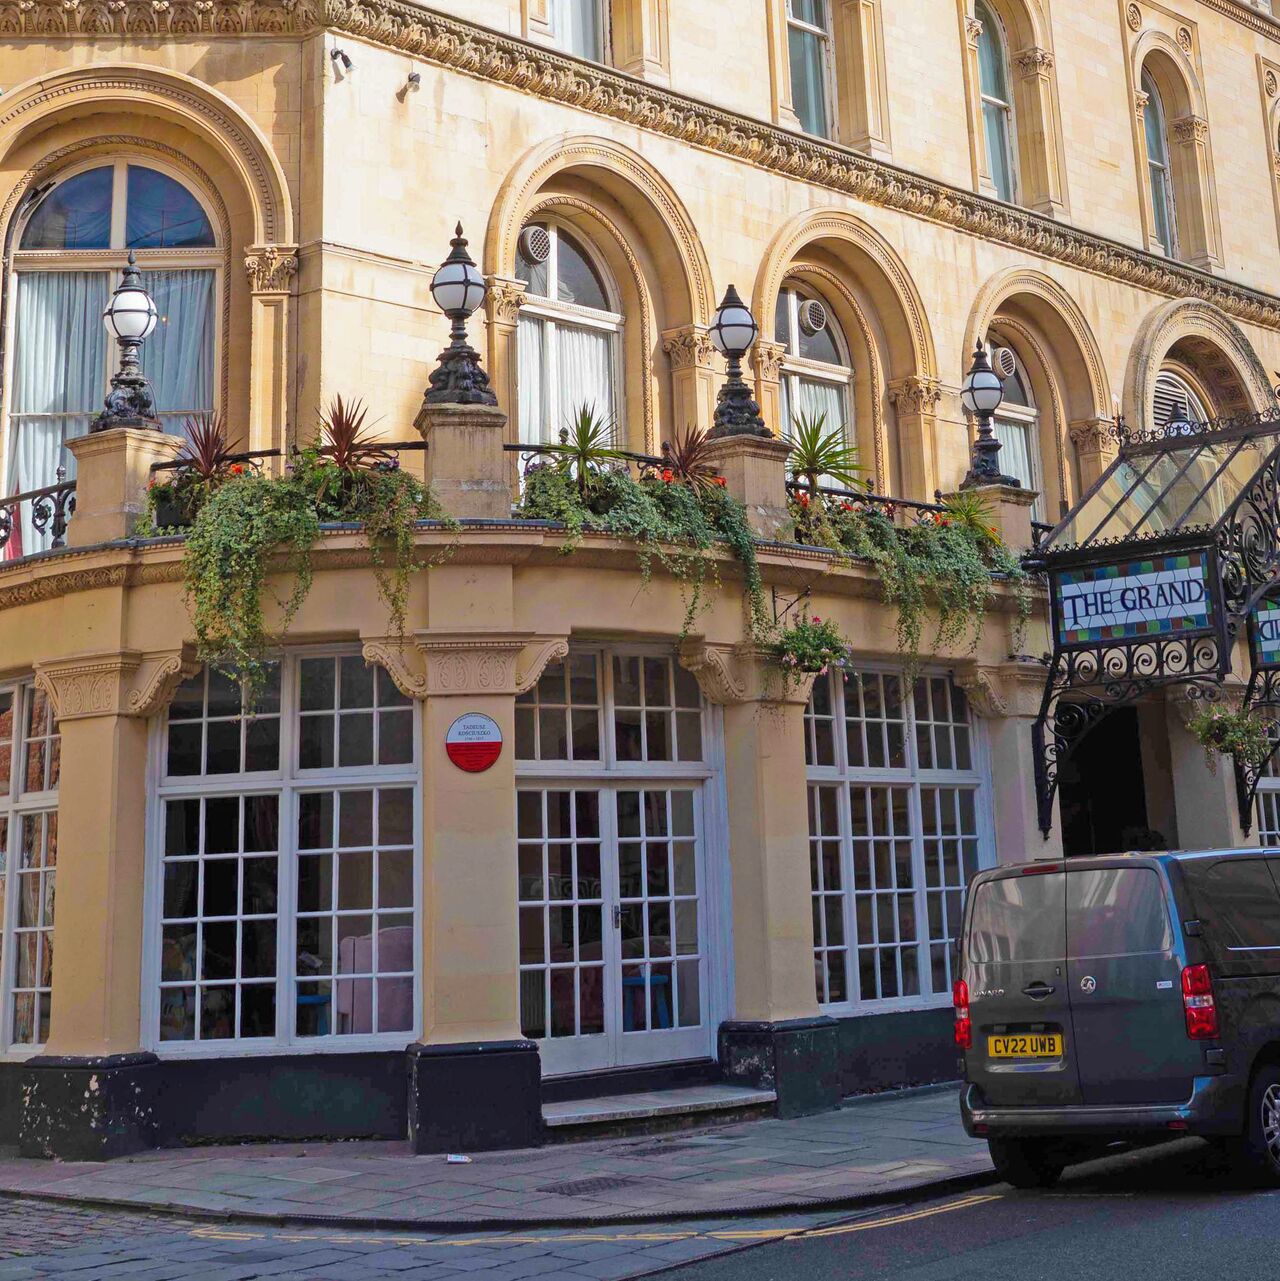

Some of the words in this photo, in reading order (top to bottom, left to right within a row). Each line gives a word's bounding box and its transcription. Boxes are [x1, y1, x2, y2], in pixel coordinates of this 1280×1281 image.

[1064, 590, 1113, 625] THE
[1120, 579, 1205, 611] GRAND
[994, 1038, 1027, 1055] CV22
[1030, 1037, 1056, 1053] UWB
